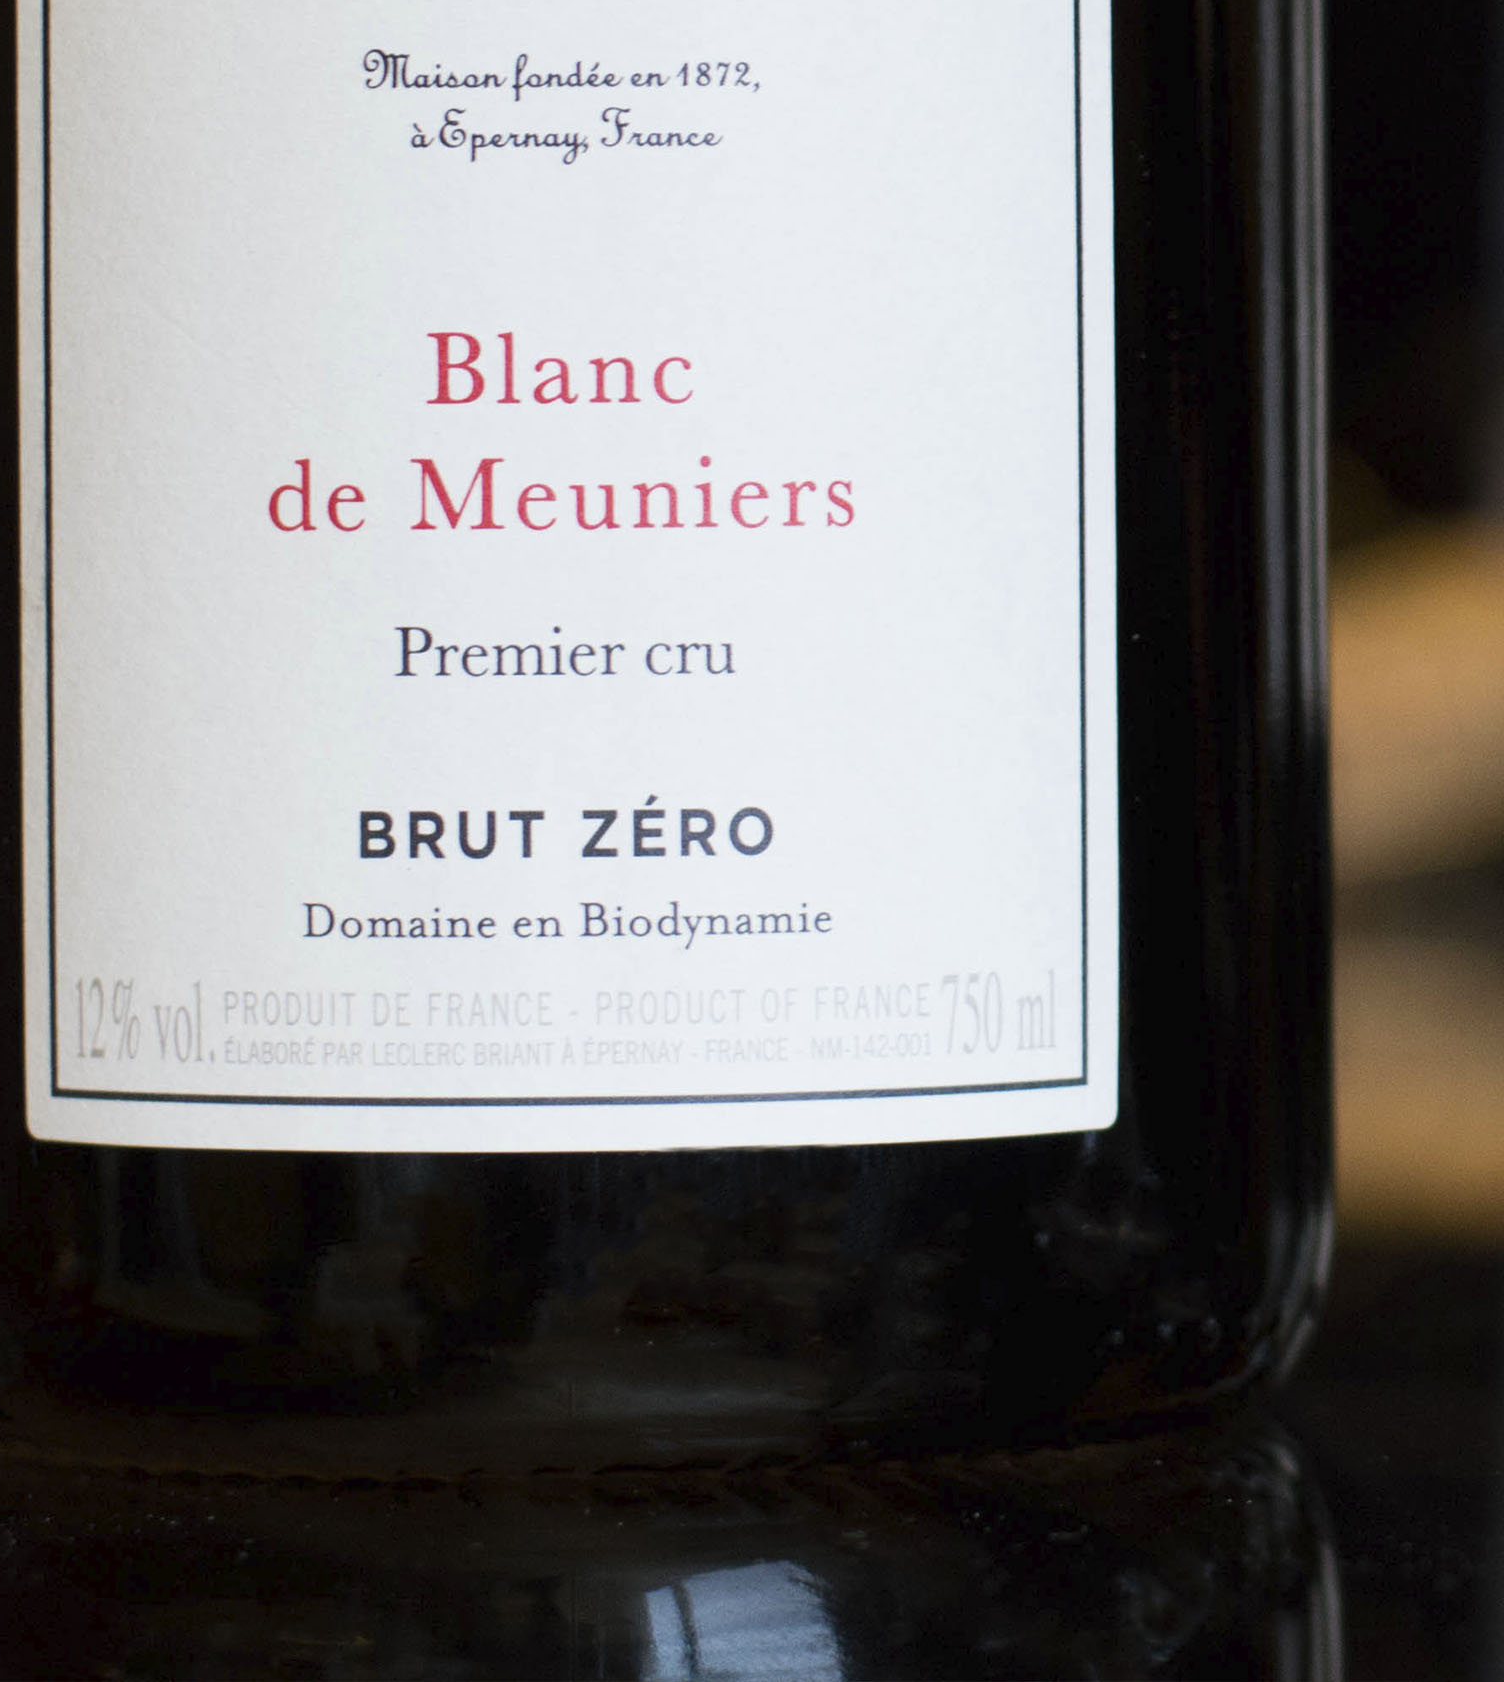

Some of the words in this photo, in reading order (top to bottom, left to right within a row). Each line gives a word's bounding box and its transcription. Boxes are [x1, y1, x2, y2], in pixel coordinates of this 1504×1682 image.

[362, 48, 506, 90] Maison
[511, 53, 624, 102] fondée
[629, 70, 669, 88] en
[676, 61, 762, 93] 1872,
[410, 122, 434, 149] à
[438, 107, 589, 165] Epernay,
[600, 106, 724, 148] France
[425, 331, 694, 406] Blanc
[267, 458, 366, 533] de
[409, 455, 856, 532] Meuniers
[394, 625, 626, 678] Premier
[644, 640, 736, 678] cru
[358, 809, 545, 860] BRUT
[581, 793, 775, 859] ZÉRO
[302, 902, 498, 940] Domaine
[512, 915, 564, 939] en
[579, 900, 833, 951] Biodynamie
[154, 978, 217, 1064] vol.
[222, 990, 357, 1027] PRODUIT
[371, 991, 412, 1027] DE
[426, 991, 554, 1027] FRANCE
[595, 988, 747, 1027] PRODUCT
[760, 986, 798, 1024] OF
[813, 981, 932, 1022] FRANCE
[940, 969, 1004, 1055] 750
[1016, 967, 1057, 1051] ml
[222, 1034, 315, 1067] ÉLABORÉ
[323, 1040, 363, 1067] PAR
[372, 1040, 466, 1067] LECLERC
[473, 1040, 555, 1067] BRIANT
[582, 1032, 685, 1067] ÉPERNAY
[703, 1034, 789, 1064] FRANCE
